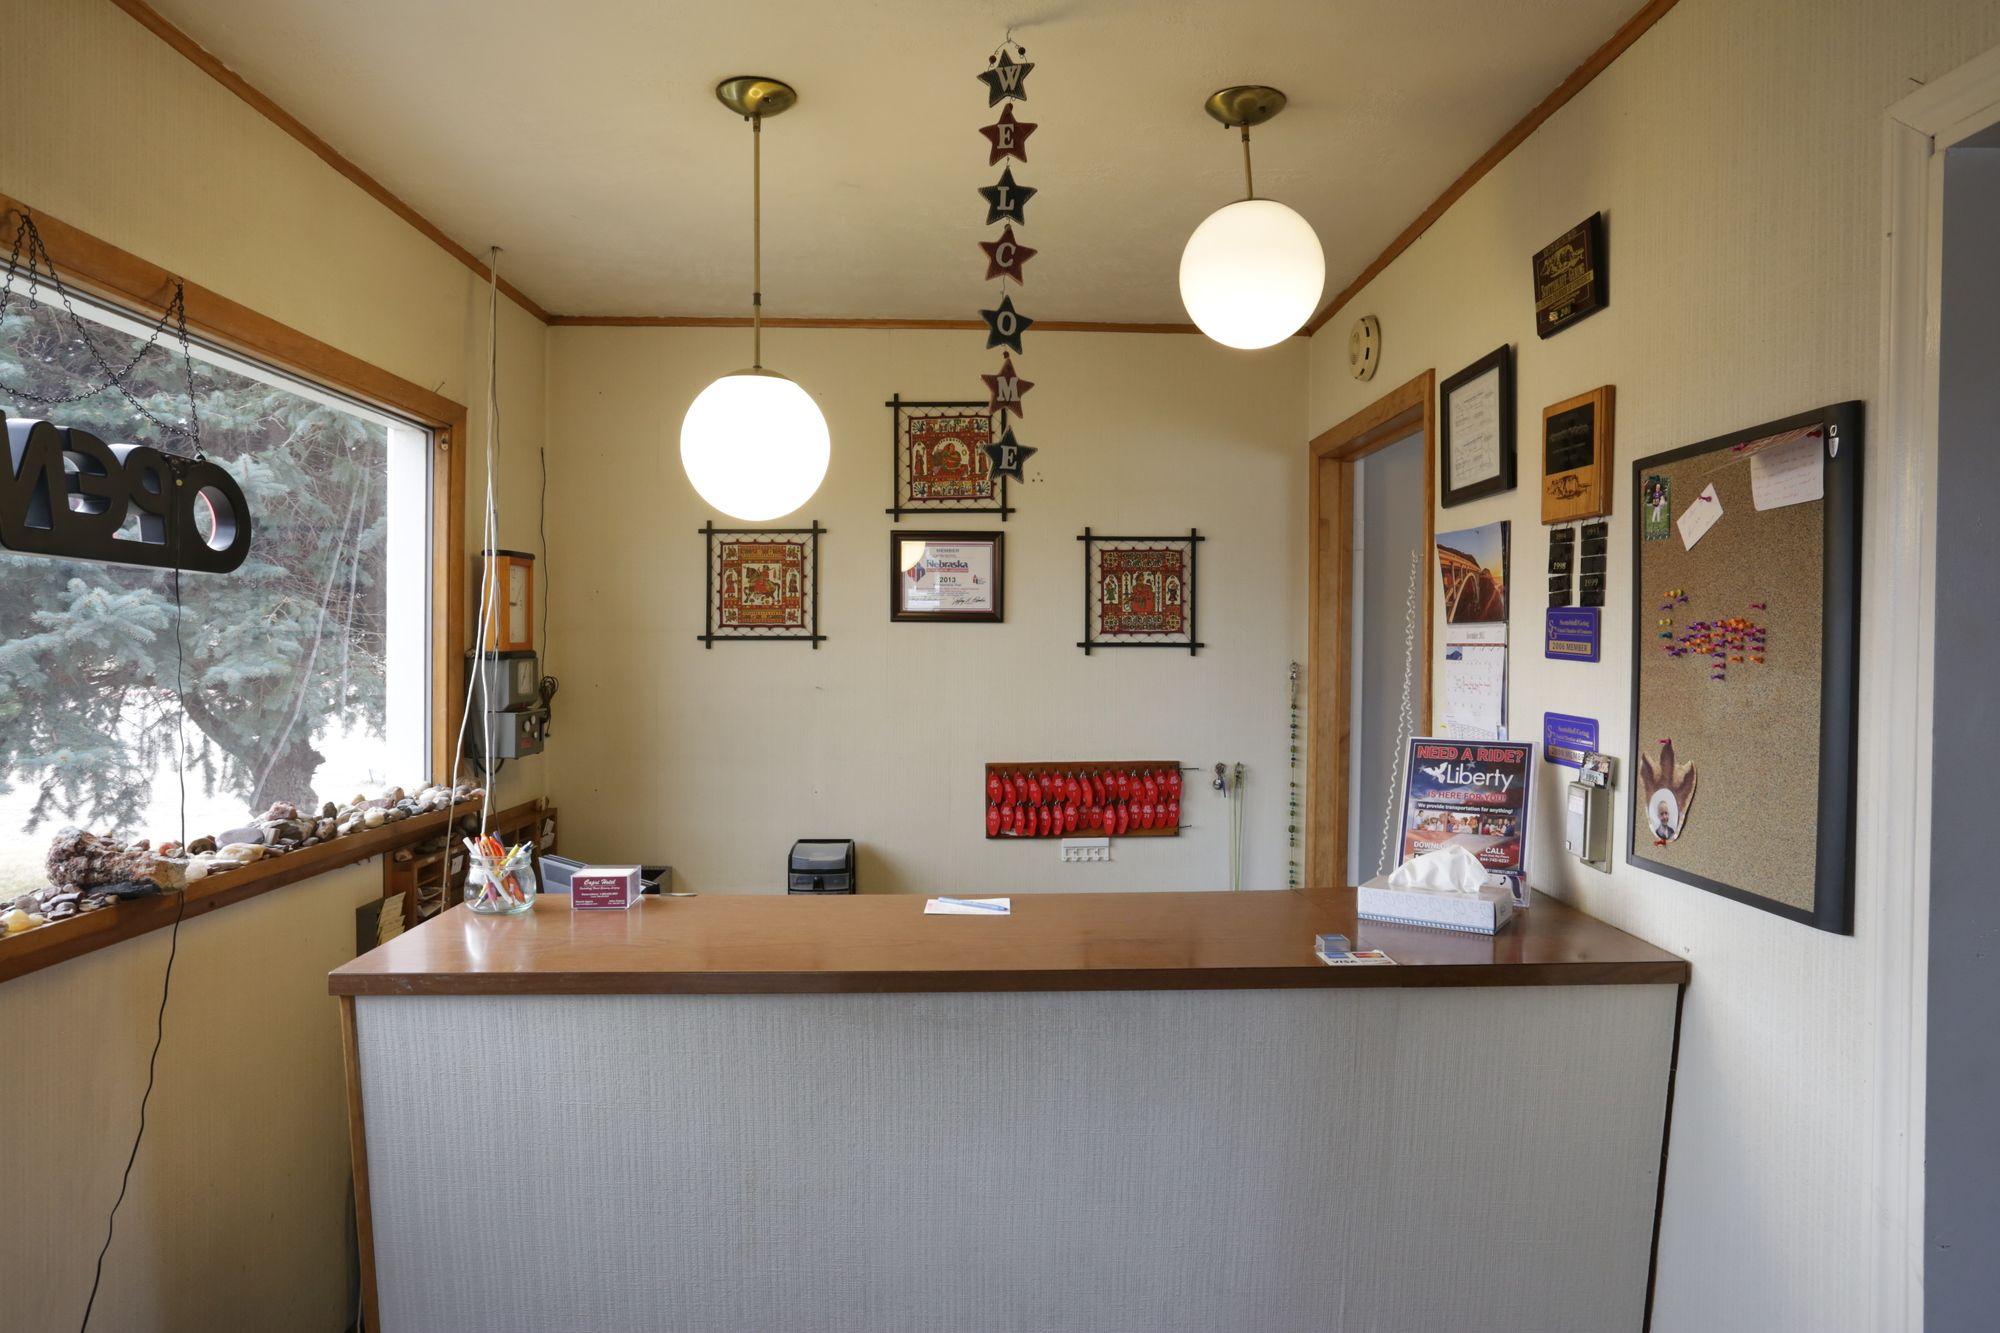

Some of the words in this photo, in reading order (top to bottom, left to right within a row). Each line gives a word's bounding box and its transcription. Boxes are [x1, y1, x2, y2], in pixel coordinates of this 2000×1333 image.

[995, 64, 1022, 470] WELCOME
[927, 560, 968, 568] Nebraska
[1417, 745, 1459, 760] NEED
[1461, 747, 1474, 761] A
[1476, 748, 1524, 763] RIDE?
[1447, 763, 1514, 792] Liberty
[1428, 790, 1437, 798] IS
[1439, 791, 1461, 800] HERE
[1464, 792, 1482, 800] FOR
[1445, 804, 1480, 812] transportation
[1489, 807, 1514, 815] anything!
